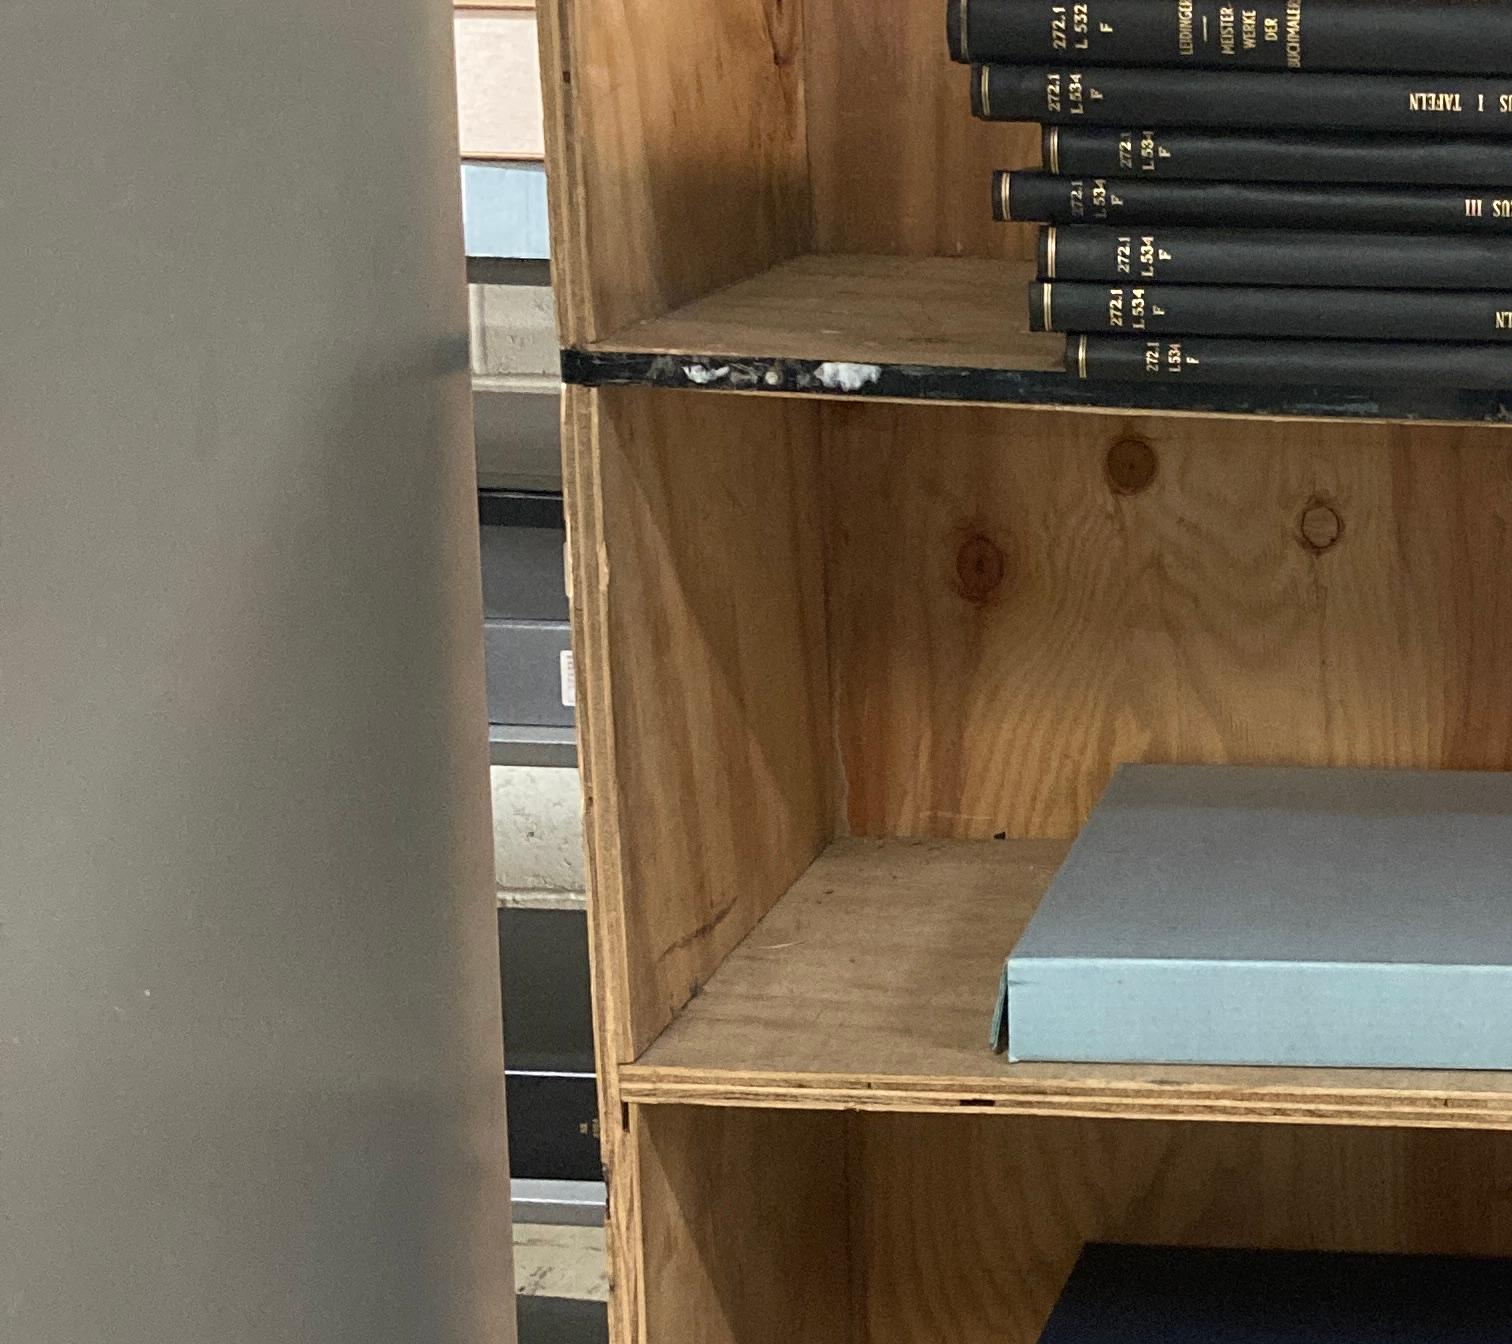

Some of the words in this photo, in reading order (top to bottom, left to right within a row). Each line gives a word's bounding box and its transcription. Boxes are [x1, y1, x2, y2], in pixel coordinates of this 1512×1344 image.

[1053, 5, 1066, 49] 272.1
[1100, 23, 1113, 33] F
[1242, 10, 1256, 48] WERKE
[1264, 18, 1278, 41] DER
[1047, 73, 1061, 112] 272.1
[1090, 89, 1104, 99] F
[1408, 94, 1461, 112] TAFELN
[1478, 94, 1484, 112] I
[1159, 147, 1171, 158] F
[1110, 195, 1123, 206] F
[1465, 200, 1482, 217] III
[1118, 236, 1131, 273] 272.1
[1159, 249, 1172, 260] F
[1110, 288, 1123, 326] 272.1
[1153, 305, 1165, 315] F
[1146, 342, 1160, 371] 272.1
[1186, 356, 1199, 364] F
